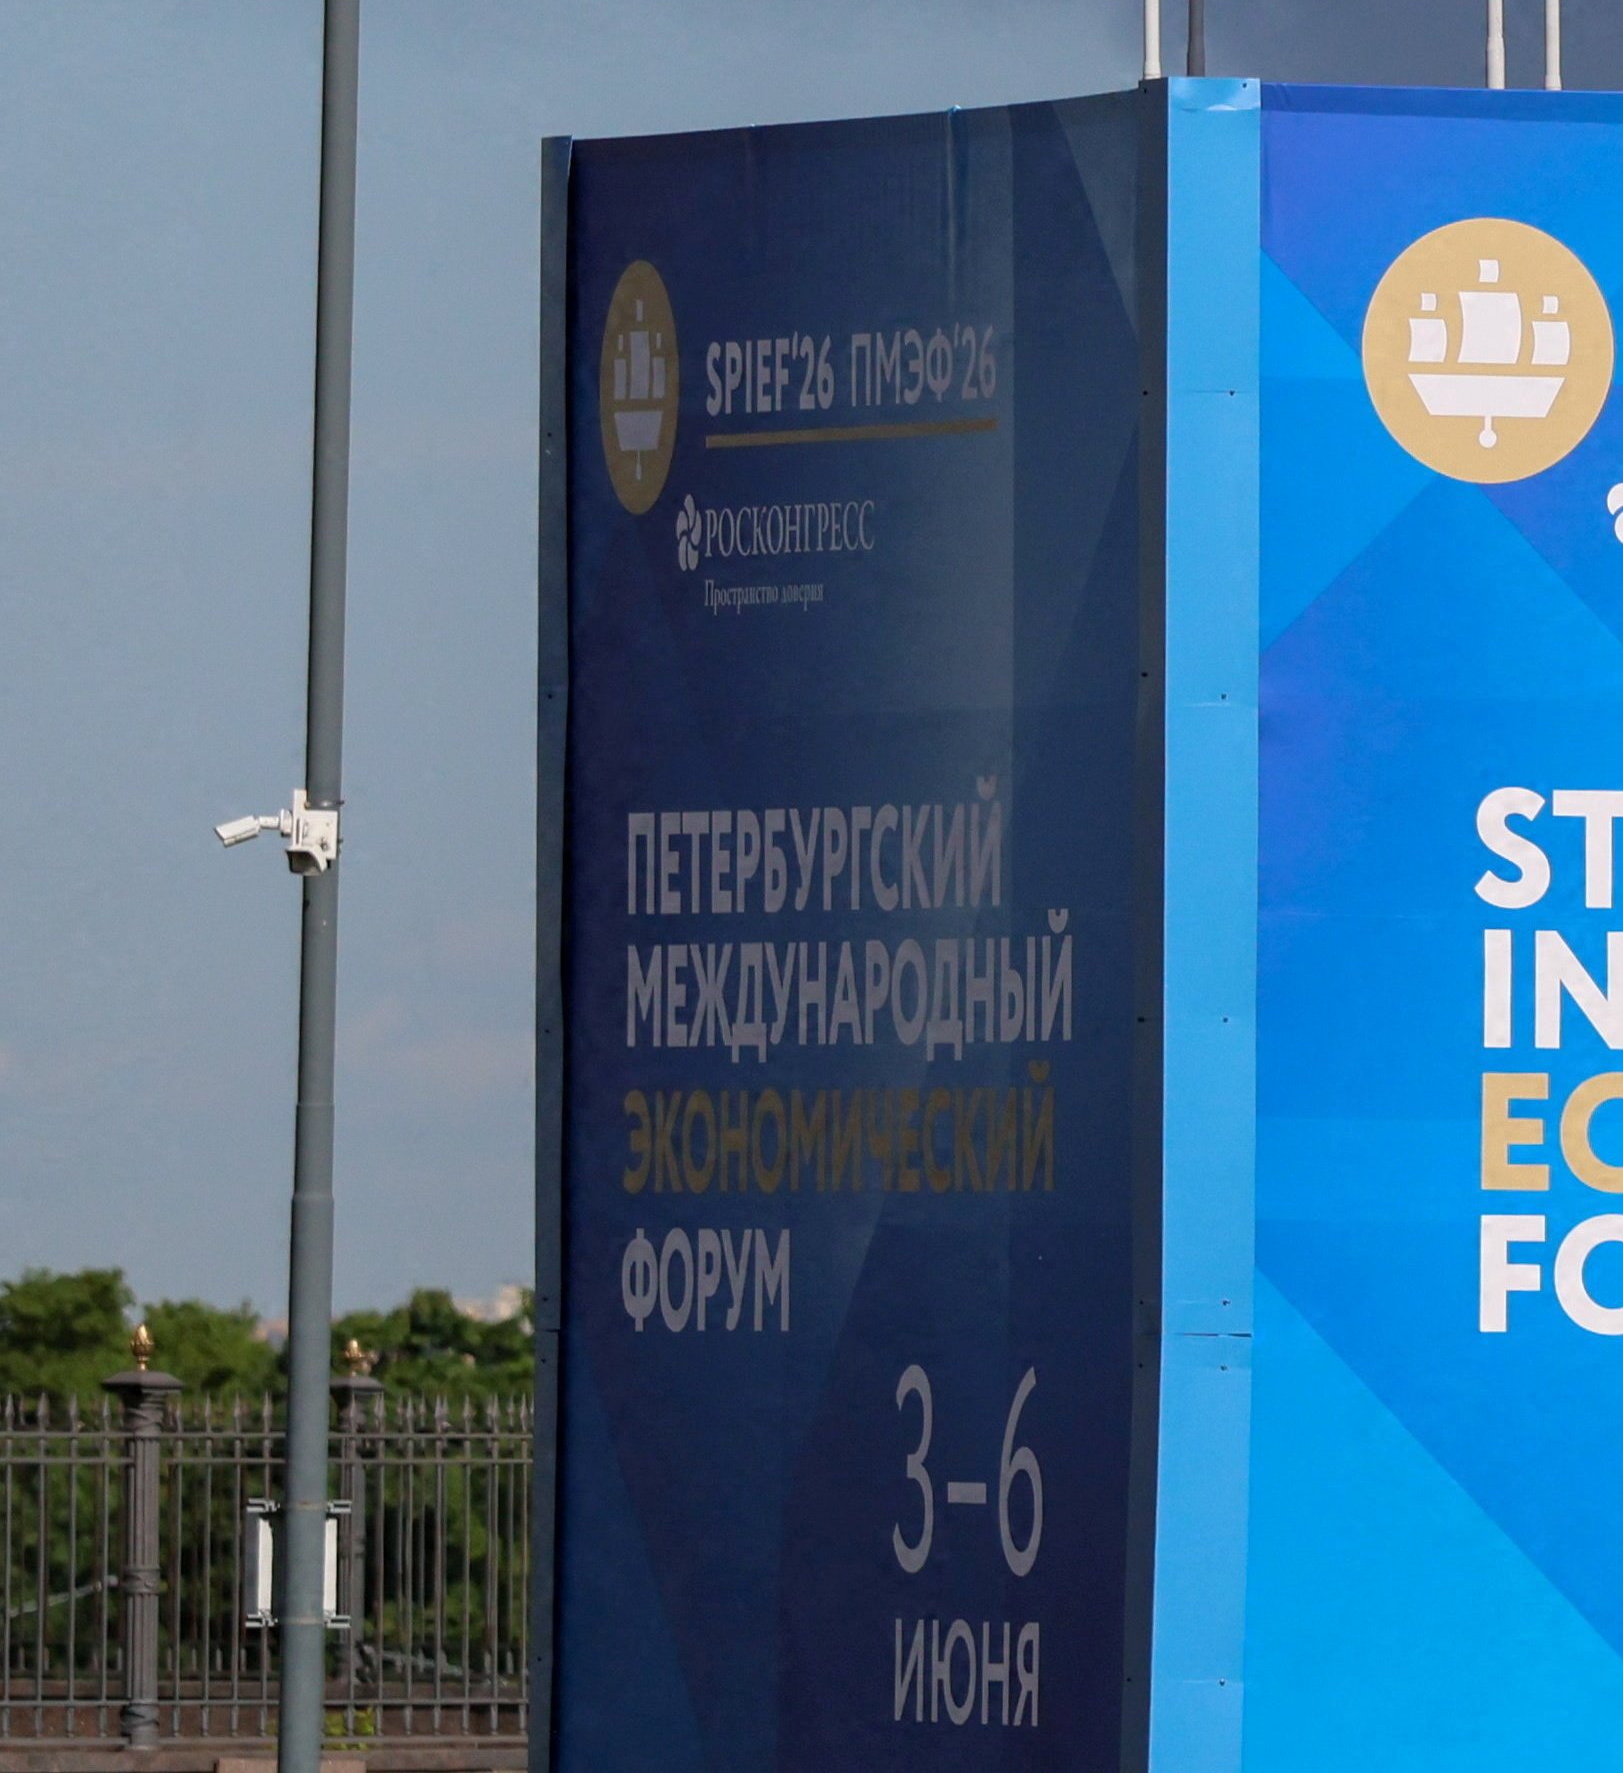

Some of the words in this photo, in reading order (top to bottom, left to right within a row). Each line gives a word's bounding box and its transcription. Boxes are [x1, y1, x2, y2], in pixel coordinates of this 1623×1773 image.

[704, 499, 875, 558] РОСКОНГРЕСС
[704, 579, 779, 616] Пространство
[781, 583, 824, 612] доверия
[627, 775, 1001, 914] ПЕТЕРБУРГСКИЙ
[626, 908, 1073, 1063] МЕЖДУНАРОДНЫЙ
[623, 1060, 1055, 1194] ЭКОНОМИЧЕСКИЙ
[621, 1227, 791, 1333] ФОРУМ
[894, 1618, 1040, 1727] ИЮНЯ
